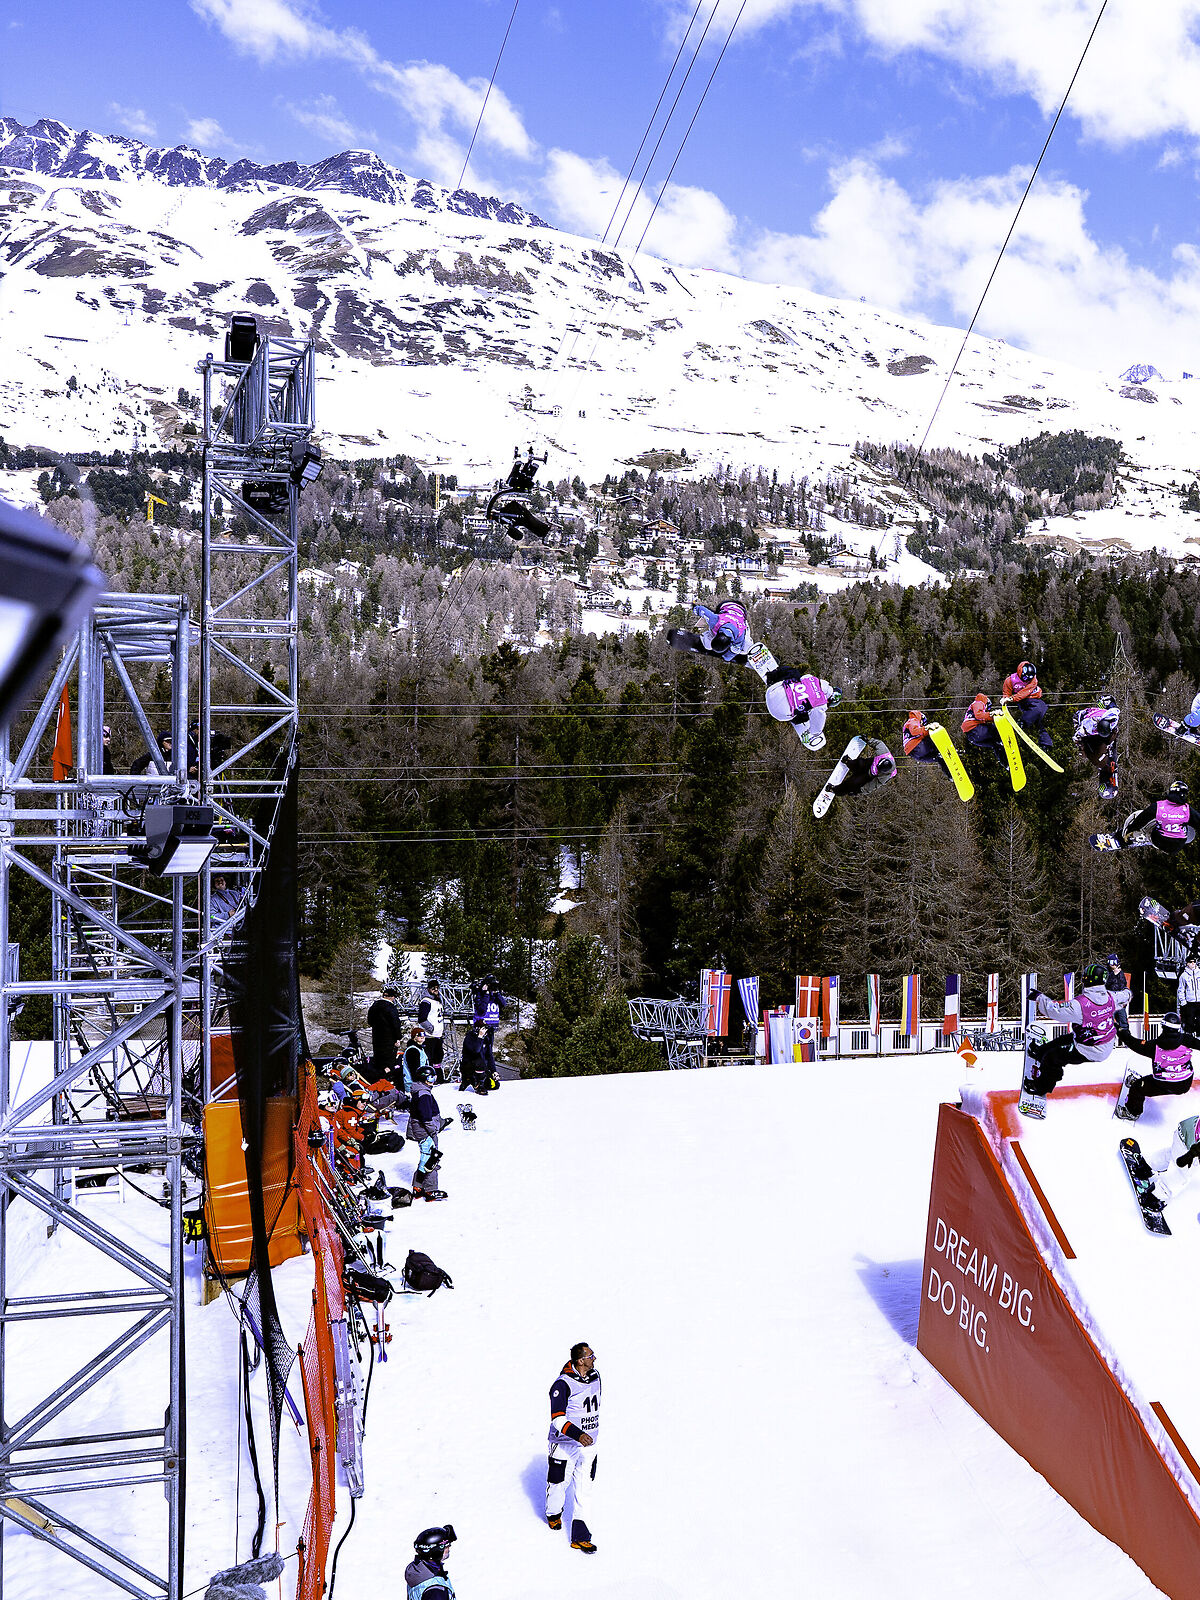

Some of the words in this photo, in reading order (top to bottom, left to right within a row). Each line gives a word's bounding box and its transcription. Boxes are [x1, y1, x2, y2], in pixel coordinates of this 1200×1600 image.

[795, 684, 809, 700] 01
[1165, 824, 1181, 832] 12
[934, 1217, 998, 1297] DREAM
[998, 1272, 1035, 1333] BIG.
[928, 1267, 956, 1316] DO
[958, 1294, 990, 1354] BIG.
[583, 1395, 598, 1413] 11
